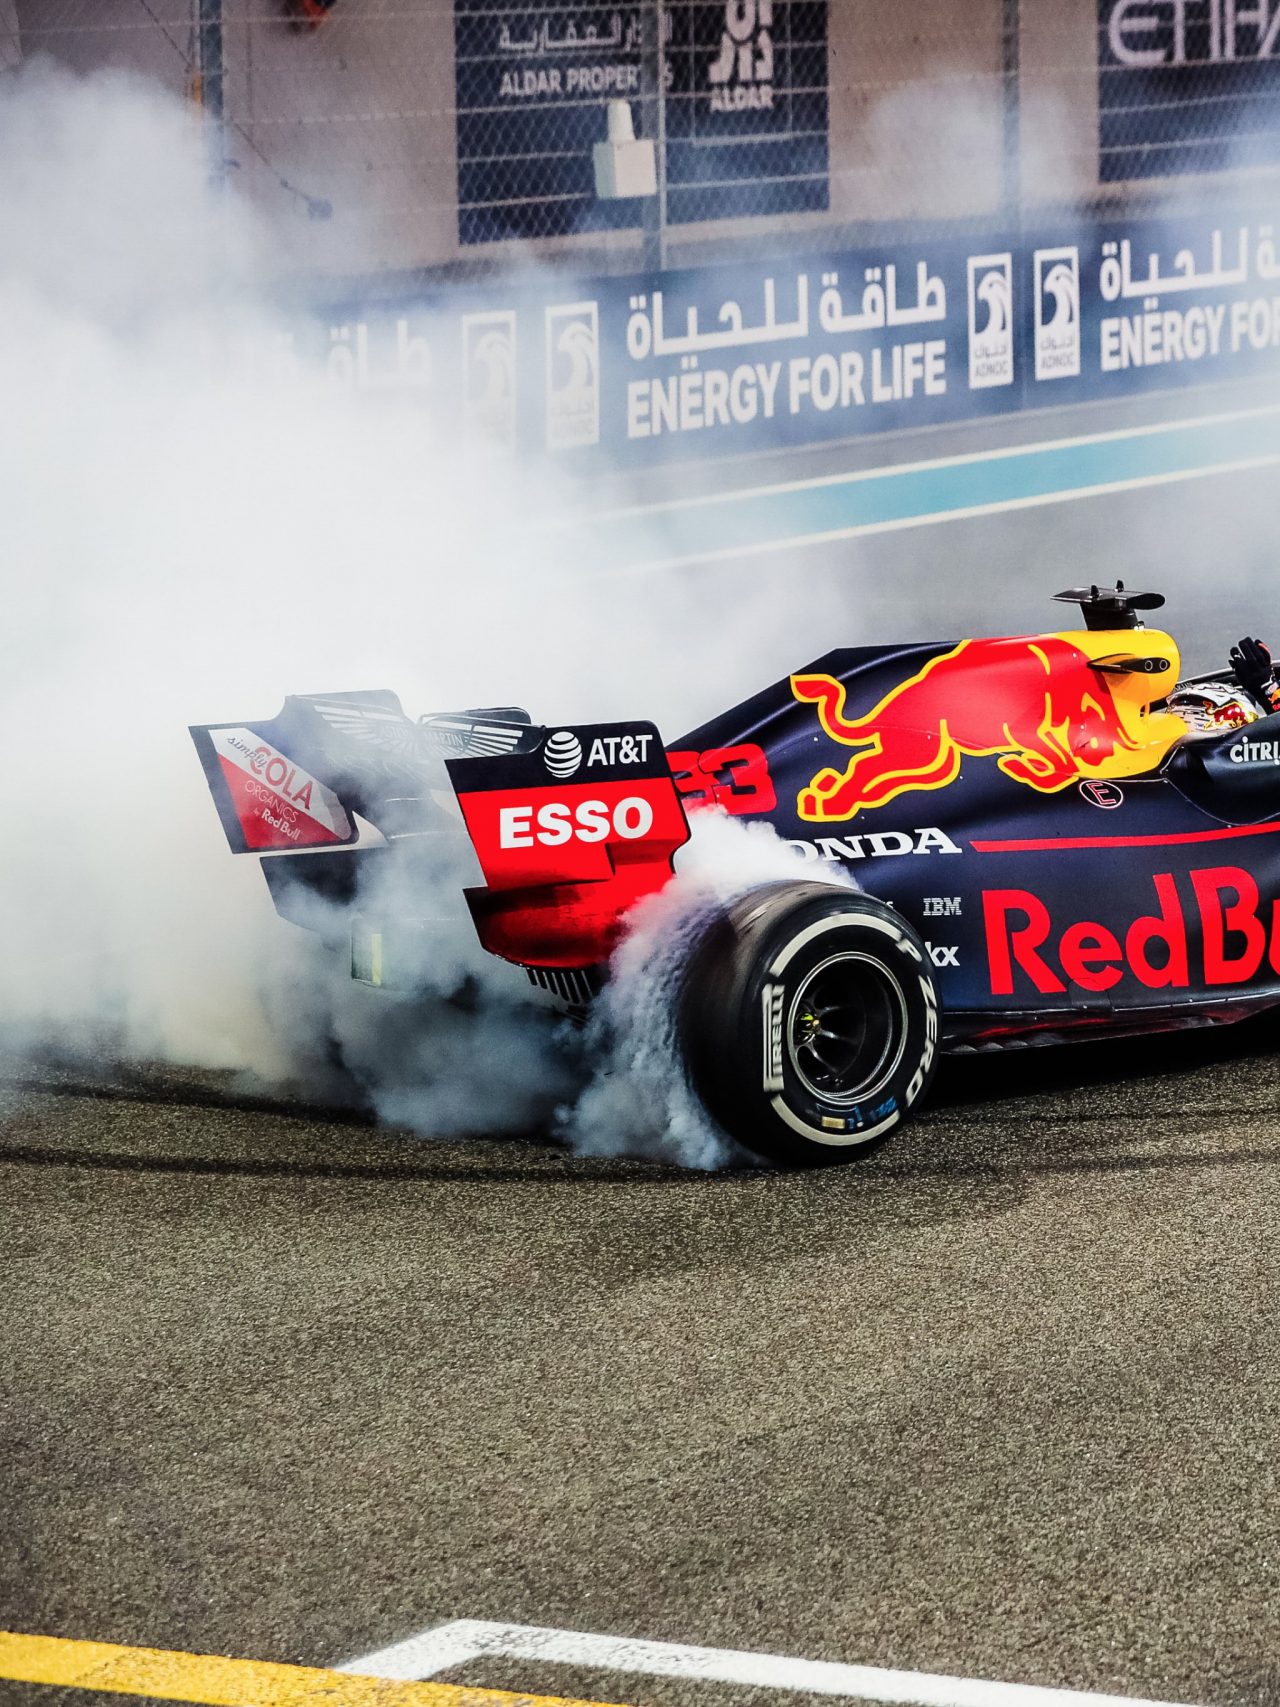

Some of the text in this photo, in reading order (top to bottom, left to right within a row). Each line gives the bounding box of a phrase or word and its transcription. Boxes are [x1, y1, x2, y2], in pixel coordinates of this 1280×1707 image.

[500, 62, 674, 96] ALDAR PROPERS
[710, 84, 773, 111] ALDAR
[627, 262, 946, 368] طاقة للحياة
[1100, 304, 1225, 371] ENERGY
[628, 340, 946, 439] ENERGY FOR LIFE
[227, 736, 268, 769] simply
[586, 734, 653, 767] AT&T
[250, 746, 313, 810] COLA
[1086, 783, 1117, 805] E
[244, 779, 299, 823] ORGANICS
[500, 797, 653, 849] ESSO
[784, 827, 962, 863] ONDA
[923, 897, 962, 916] IBM
[762, 983, 785, 1092] PIRELLI
[905, 975, 938, 1108] ZERO
